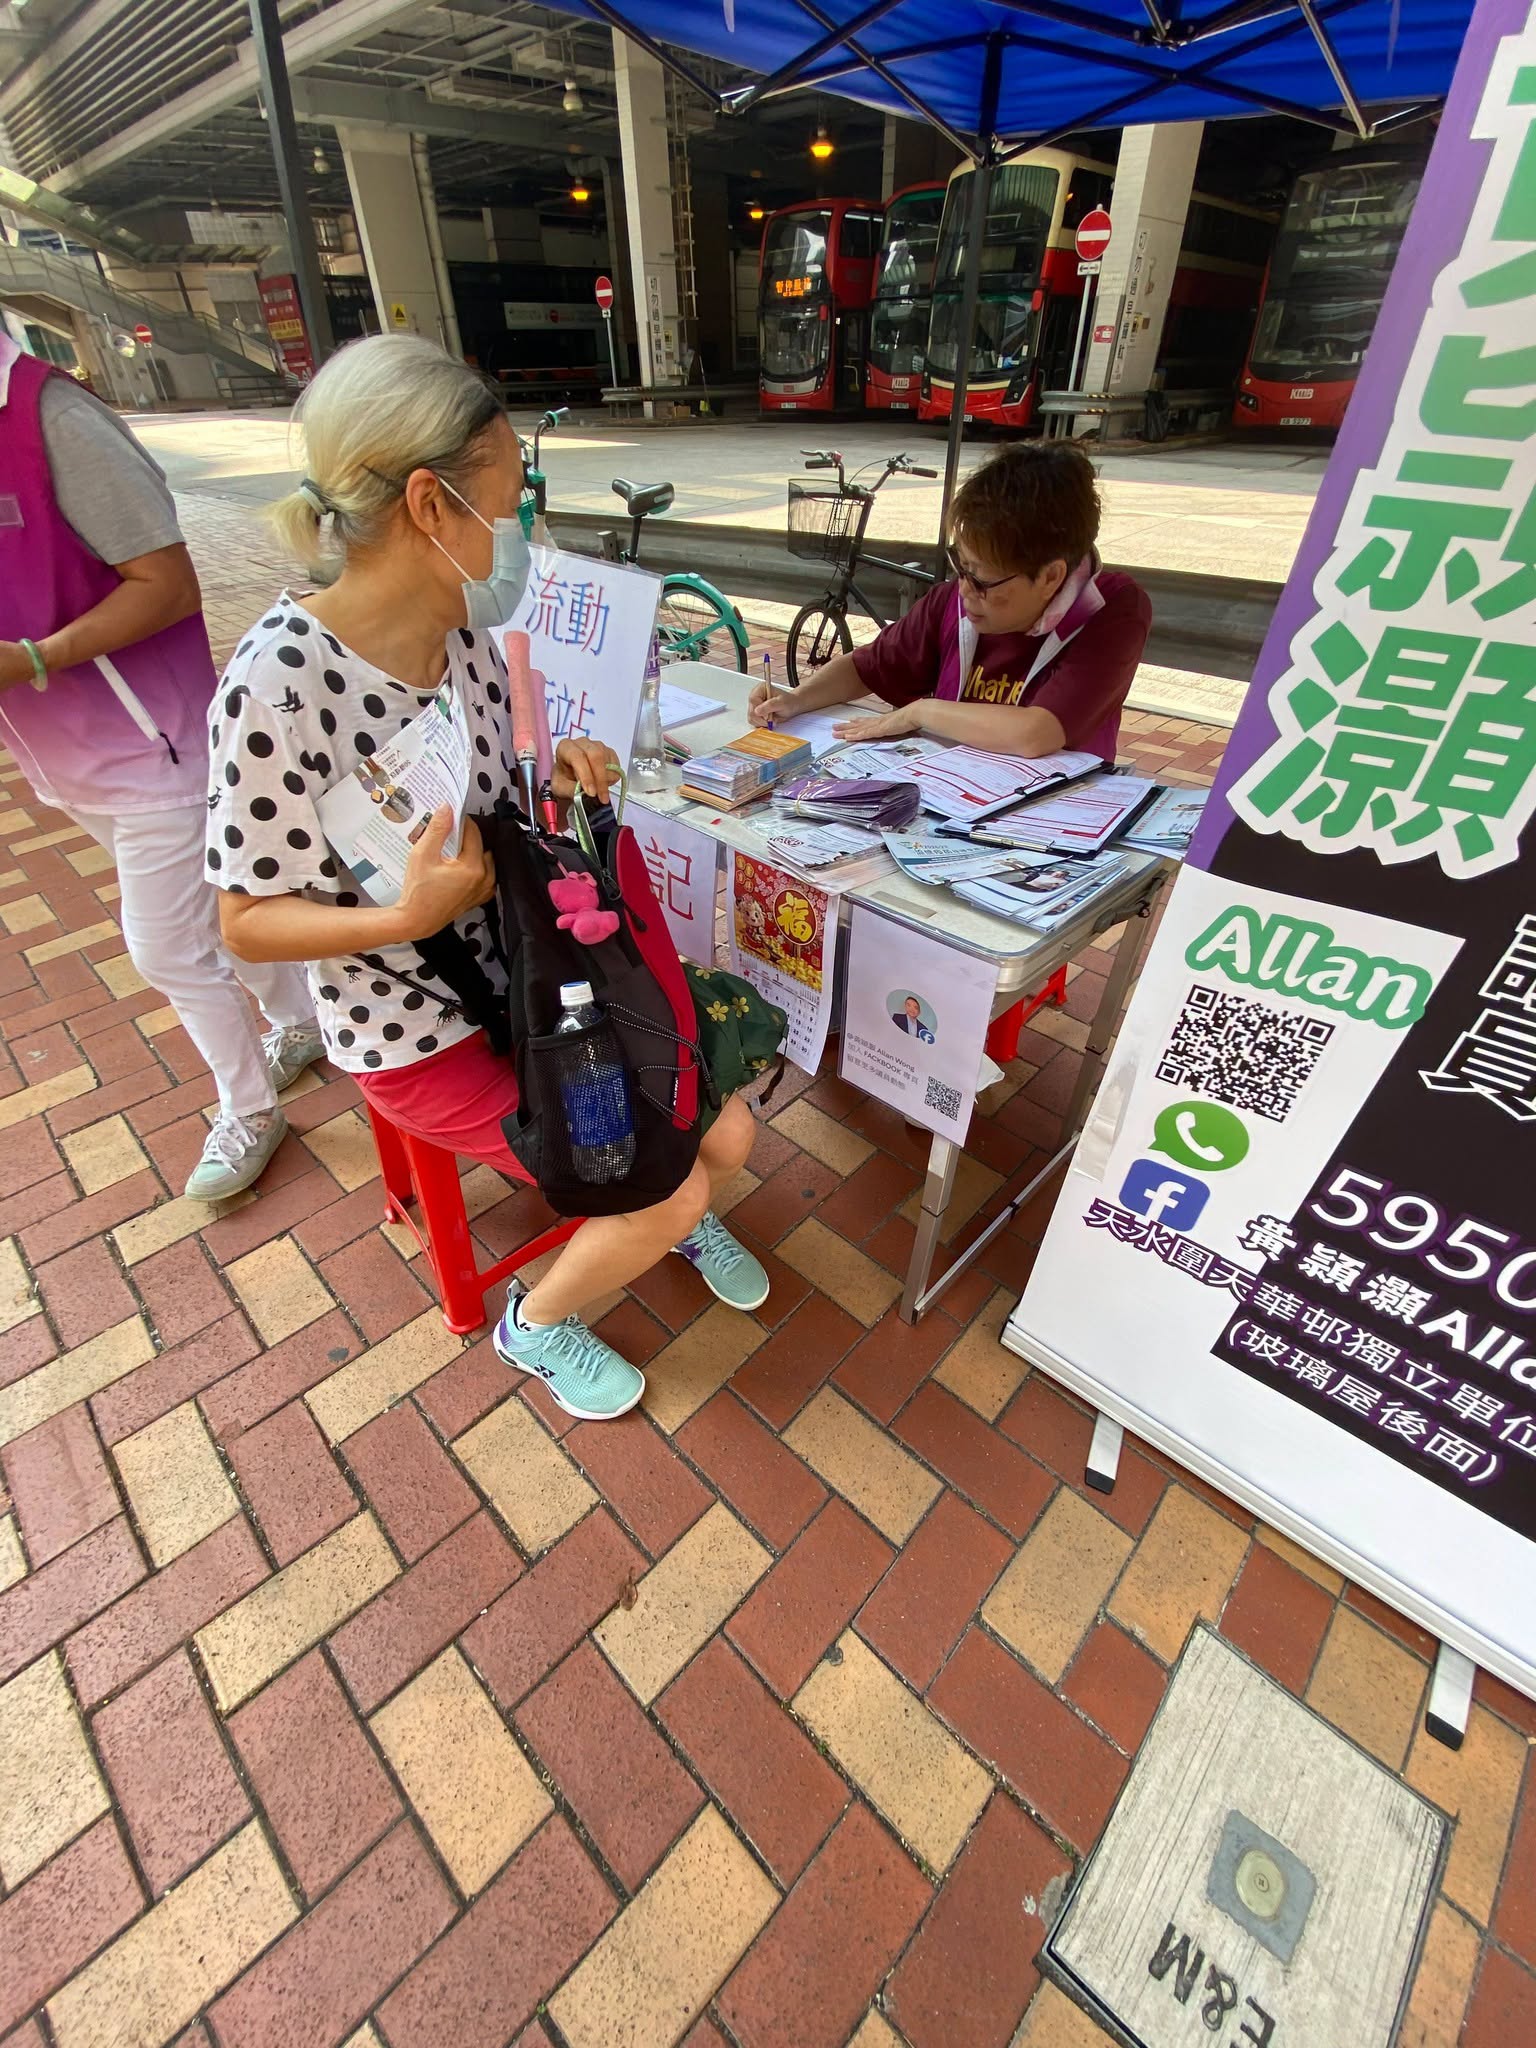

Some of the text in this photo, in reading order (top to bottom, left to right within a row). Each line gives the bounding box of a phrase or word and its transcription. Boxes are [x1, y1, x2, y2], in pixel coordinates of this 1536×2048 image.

[1289, 388, 1314, 400] KMB
[525, 567, 611, 657] 流動
[545, 680, 595, 740] 站
[644, 835, 694, 921] 記
[776, 891, 813, 942] 福
[1191, 910, 1425, 1025] Allan
[895, 1056, 915, 1073] Wong
[1228, 1317, 1503, 1484] (玻璃屋後面)
